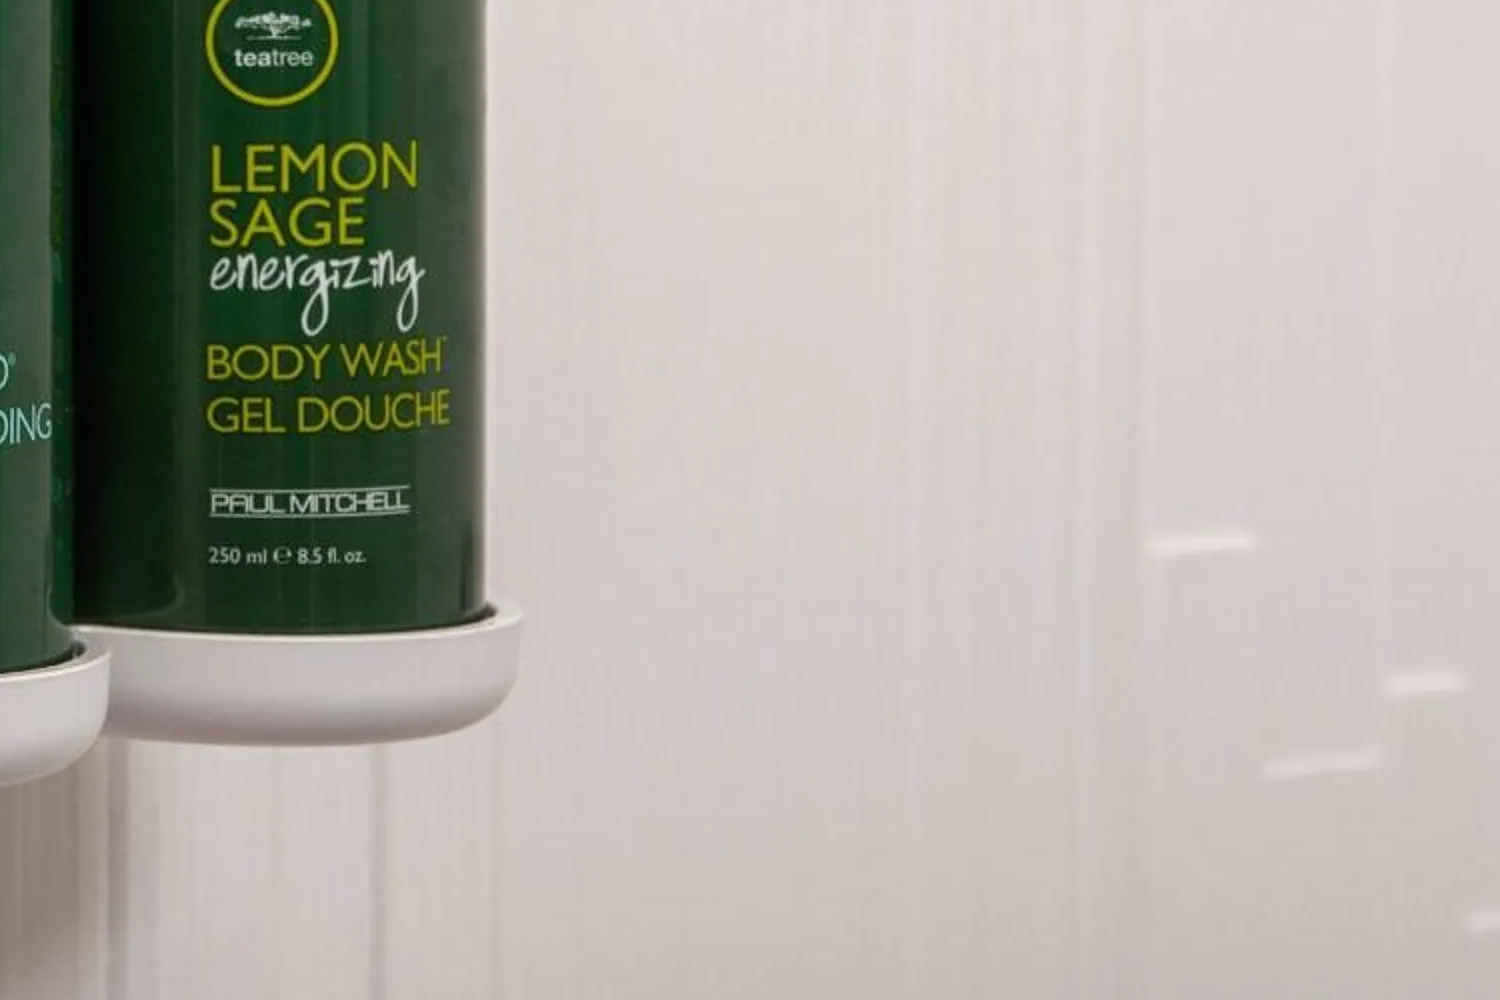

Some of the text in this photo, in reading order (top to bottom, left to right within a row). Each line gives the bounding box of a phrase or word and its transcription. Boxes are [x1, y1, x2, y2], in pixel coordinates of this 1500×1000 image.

[233, 48, 314, 68] teatree
[210, 139, 418, 194] LEMON
[209, 197, 365, 248] SAGE
[210, 248, 426, 337] energizing
[206, 336, 442, 381] BODY WASH
[206, 388, 451, 433] GEL DOUCHE
[211, 491, 410, 514] PAUL MITCHELL
[207, 546, 242, 565] 250
[245, 547, 268, 565] ml
[297, 546, 324, 565] 8.5
[326, 547, 341, 565] fl.
